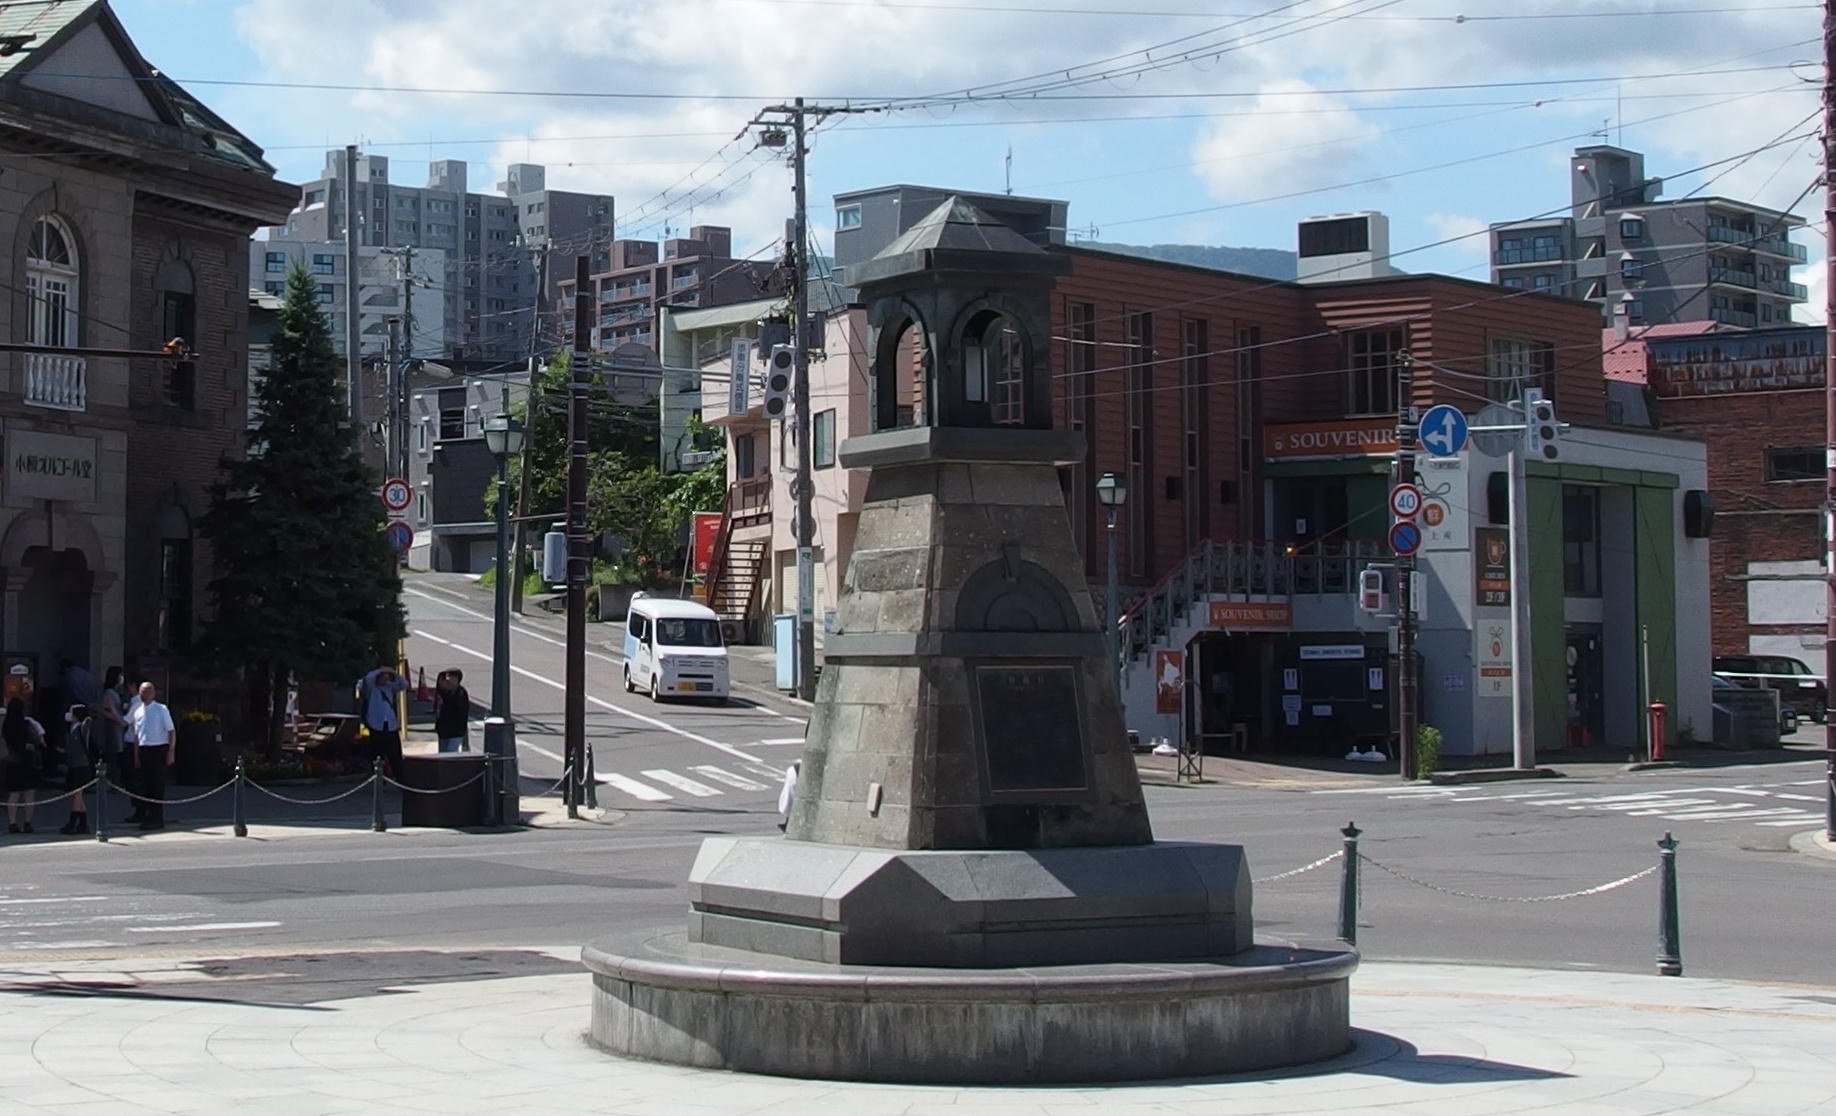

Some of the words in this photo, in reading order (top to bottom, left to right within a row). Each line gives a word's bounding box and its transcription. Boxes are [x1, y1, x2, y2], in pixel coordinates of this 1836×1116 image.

[1290, 429, 1395, 448] SOUVENIR
[15, 453, 92, 479] 小樽オルゴール堂
[389, 488, 406, 502] 30
[1397, 494, 1415, 509] 40
[1221, 609, 1264, 620] SOUVENIR
[1266, 610, 1288, 620] SHOP
